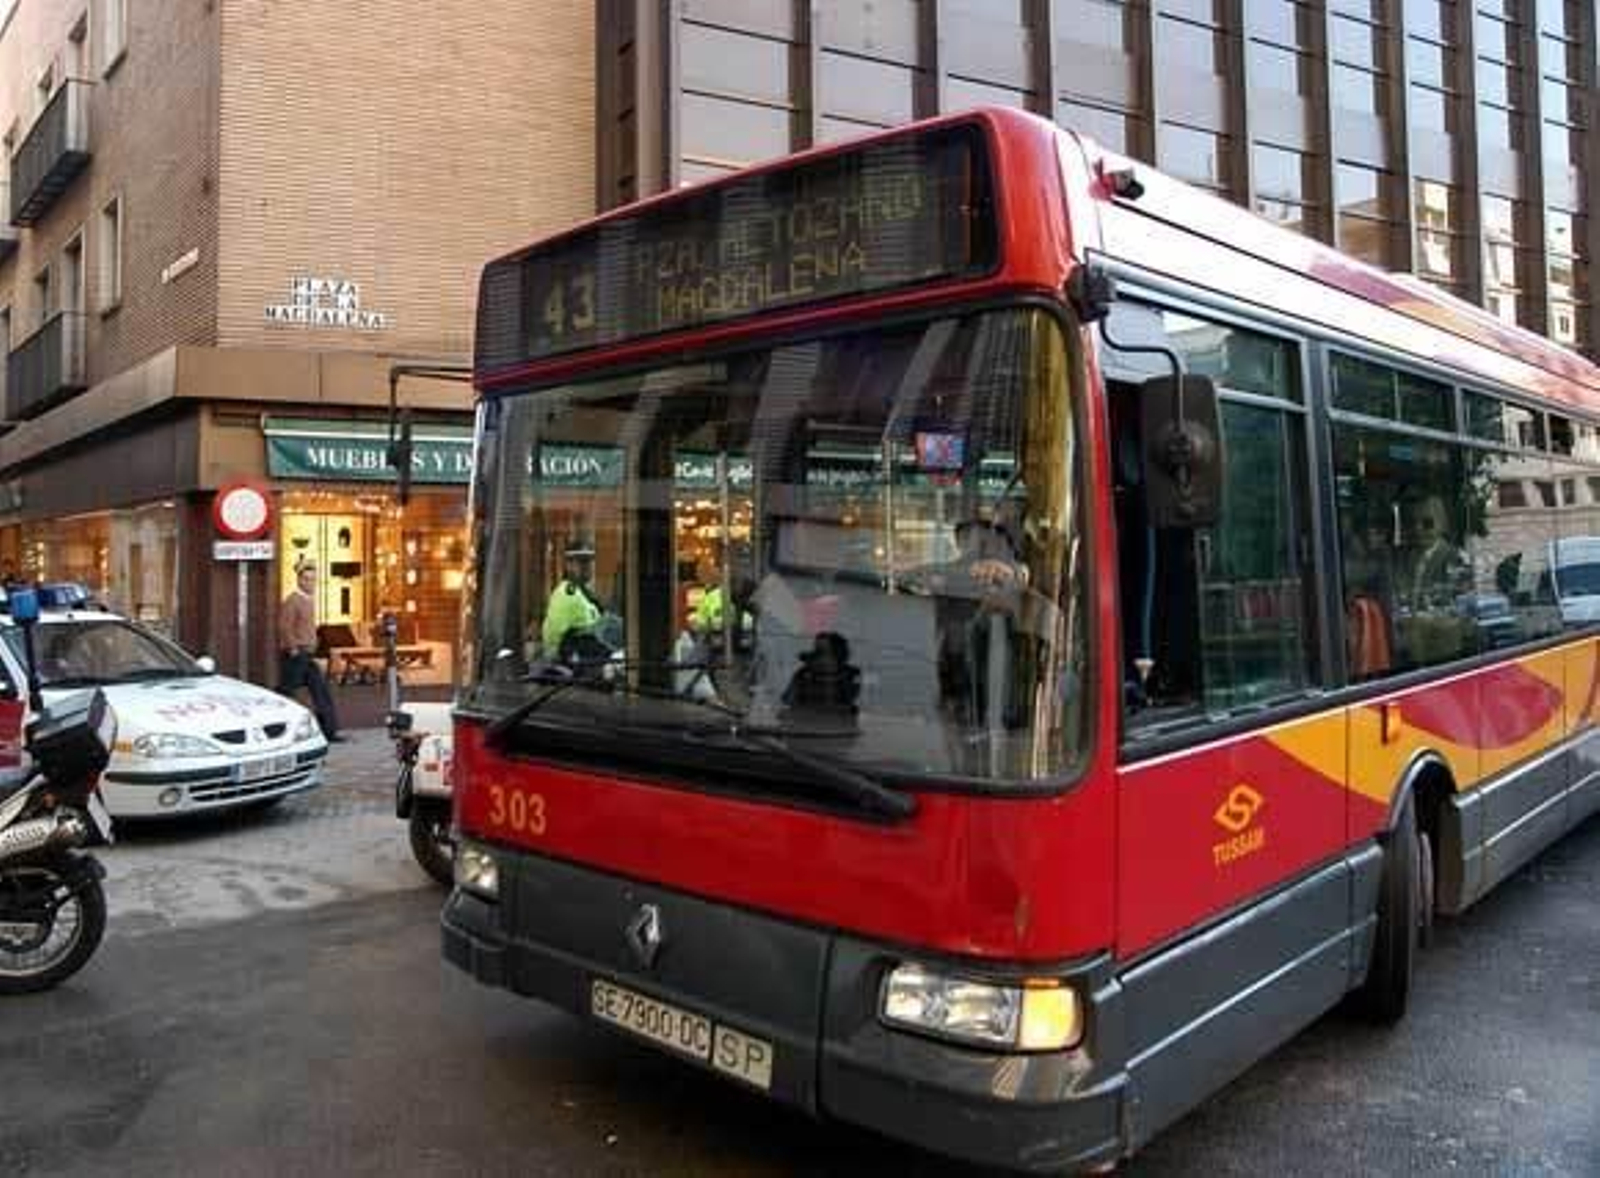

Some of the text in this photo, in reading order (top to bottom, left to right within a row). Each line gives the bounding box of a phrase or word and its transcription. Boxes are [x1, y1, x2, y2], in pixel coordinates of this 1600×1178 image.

[544, 272, 595, 333] 43
[658, 241, 867, 328] MAGDALENA
[307, 448, 424, 471] MUEBLS
[433, 451, 448, 471] Y
[488, 784, 547, 836] 303
[1212, 827, 1265, 868] TUSSAM
